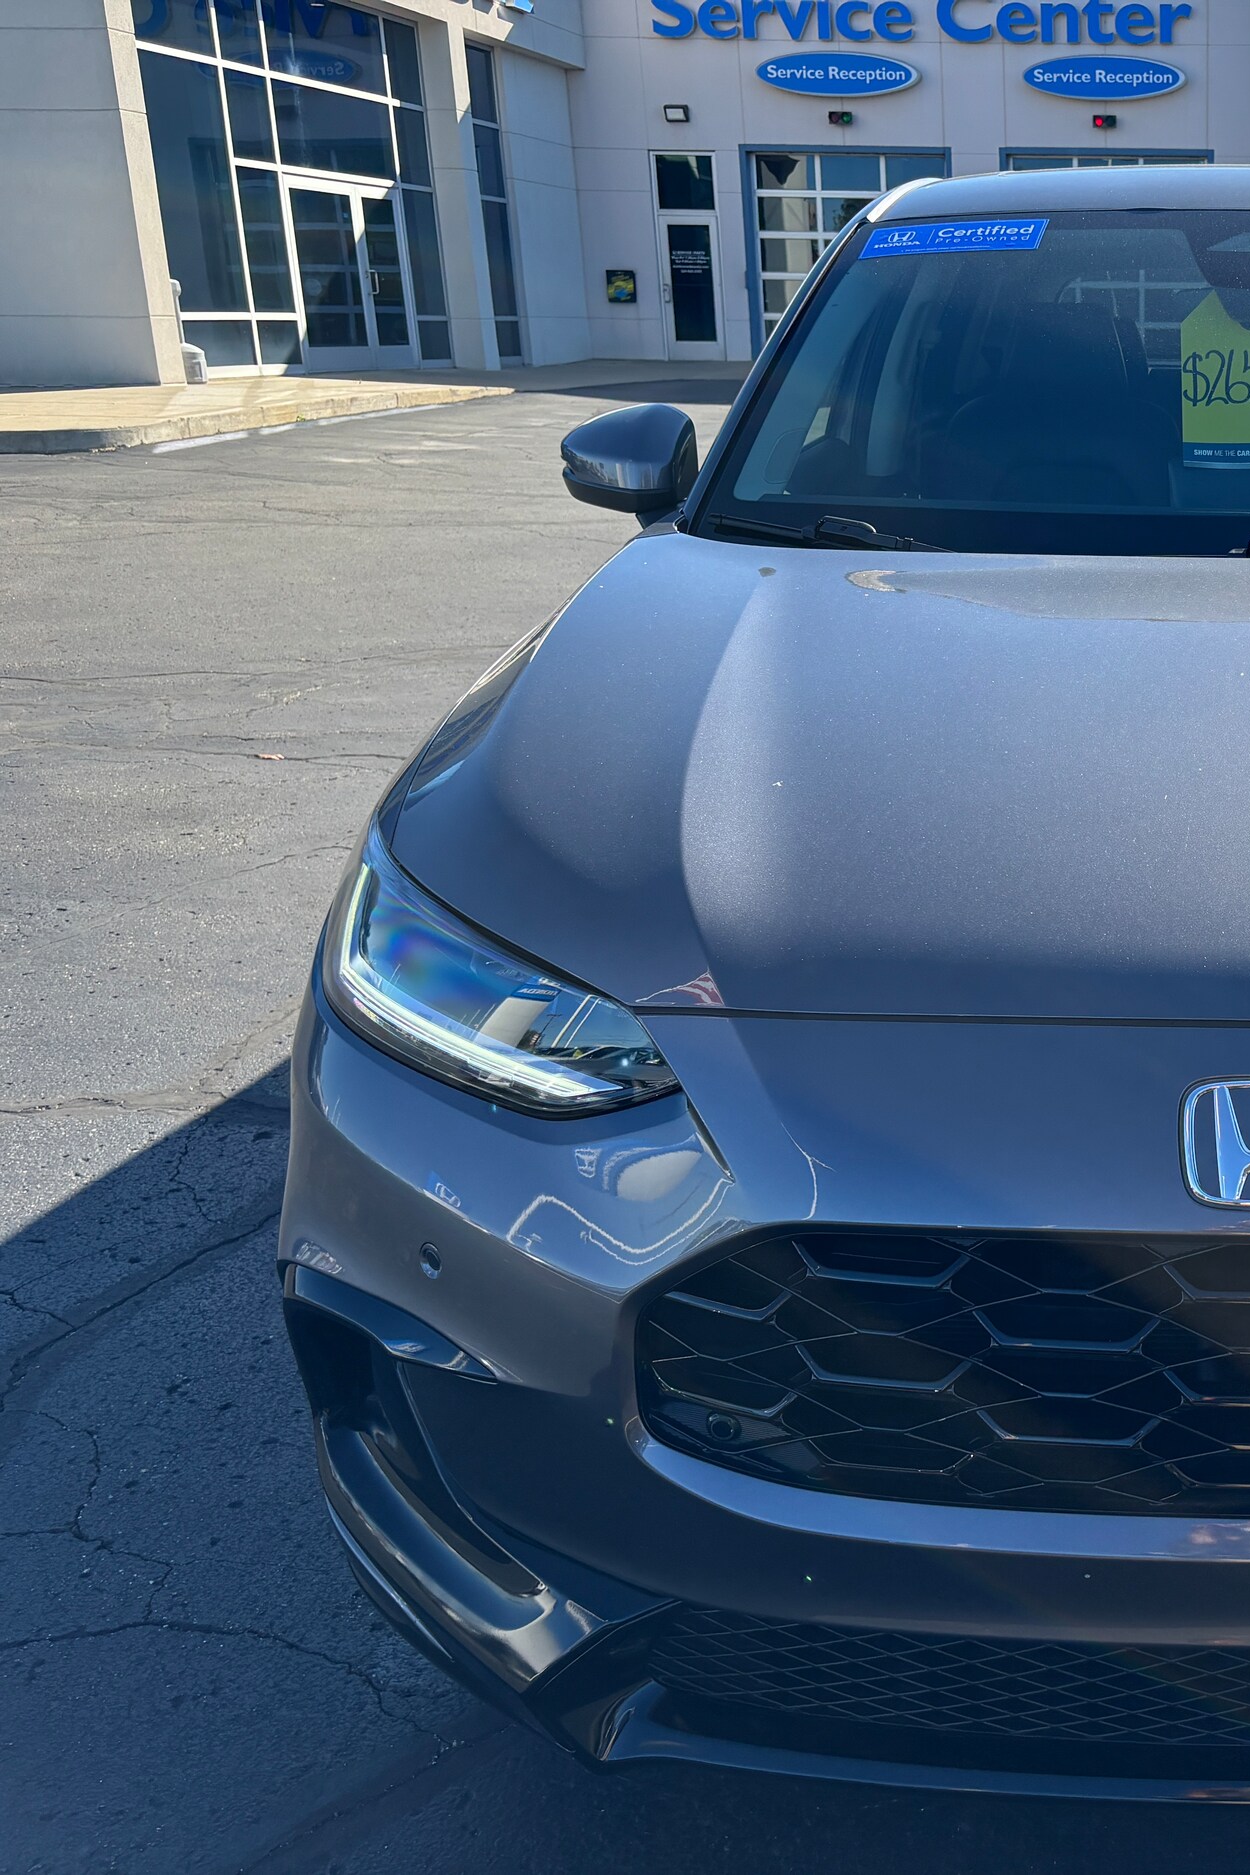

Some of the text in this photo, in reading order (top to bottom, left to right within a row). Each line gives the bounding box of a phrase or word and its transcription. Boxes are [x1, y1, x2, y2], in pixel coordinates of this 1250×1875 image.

[652, 0, 1193, 45] Service Center
[766, 64, 906, 84] Service Reception
[1033, 69, 1173, 87] Service Reception
[937, 224, 1036, 238] Certified
[873, 240, 921, 249] HONDA
[1214, 449, 1223, 457] ME
[1225, 449, 1236, 457] THE
